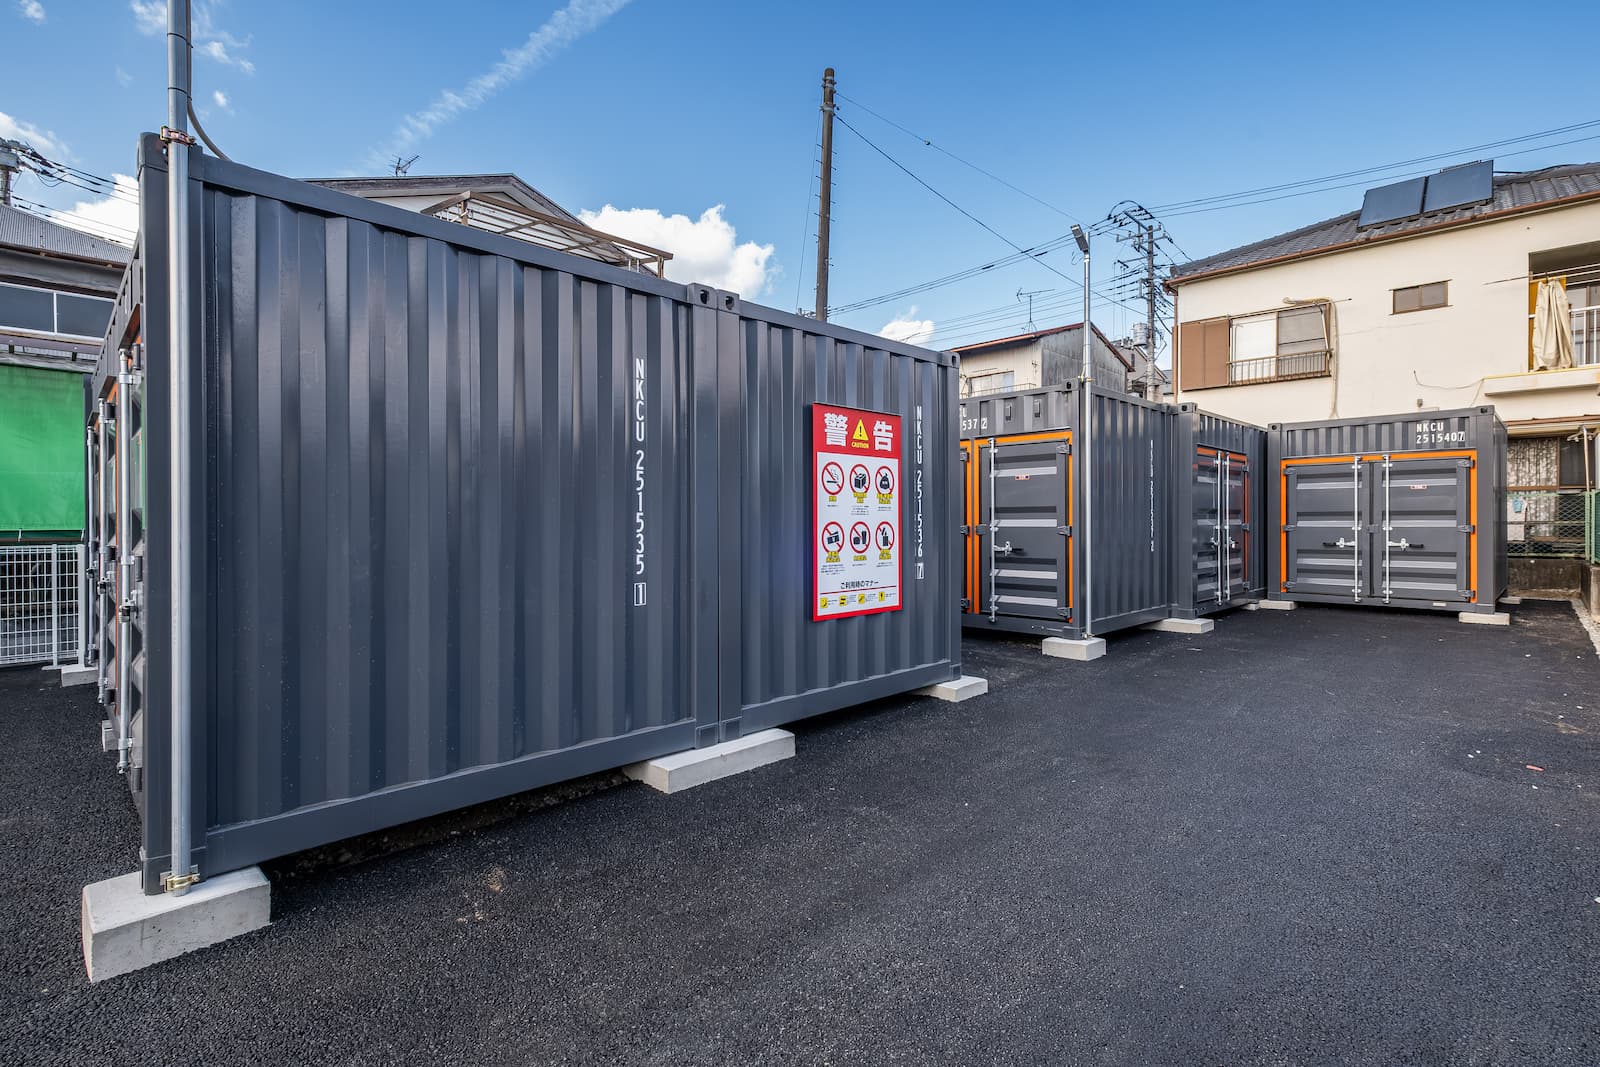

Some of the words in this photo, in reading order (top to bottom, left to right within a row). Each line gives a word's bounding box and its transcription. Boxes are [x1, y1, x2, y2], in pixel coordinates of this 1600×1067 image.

[635, 358, 645, 442] NKCU
[1416, 422, 1444, 433] NKCU
[635, 450, 645, 575] 251535
